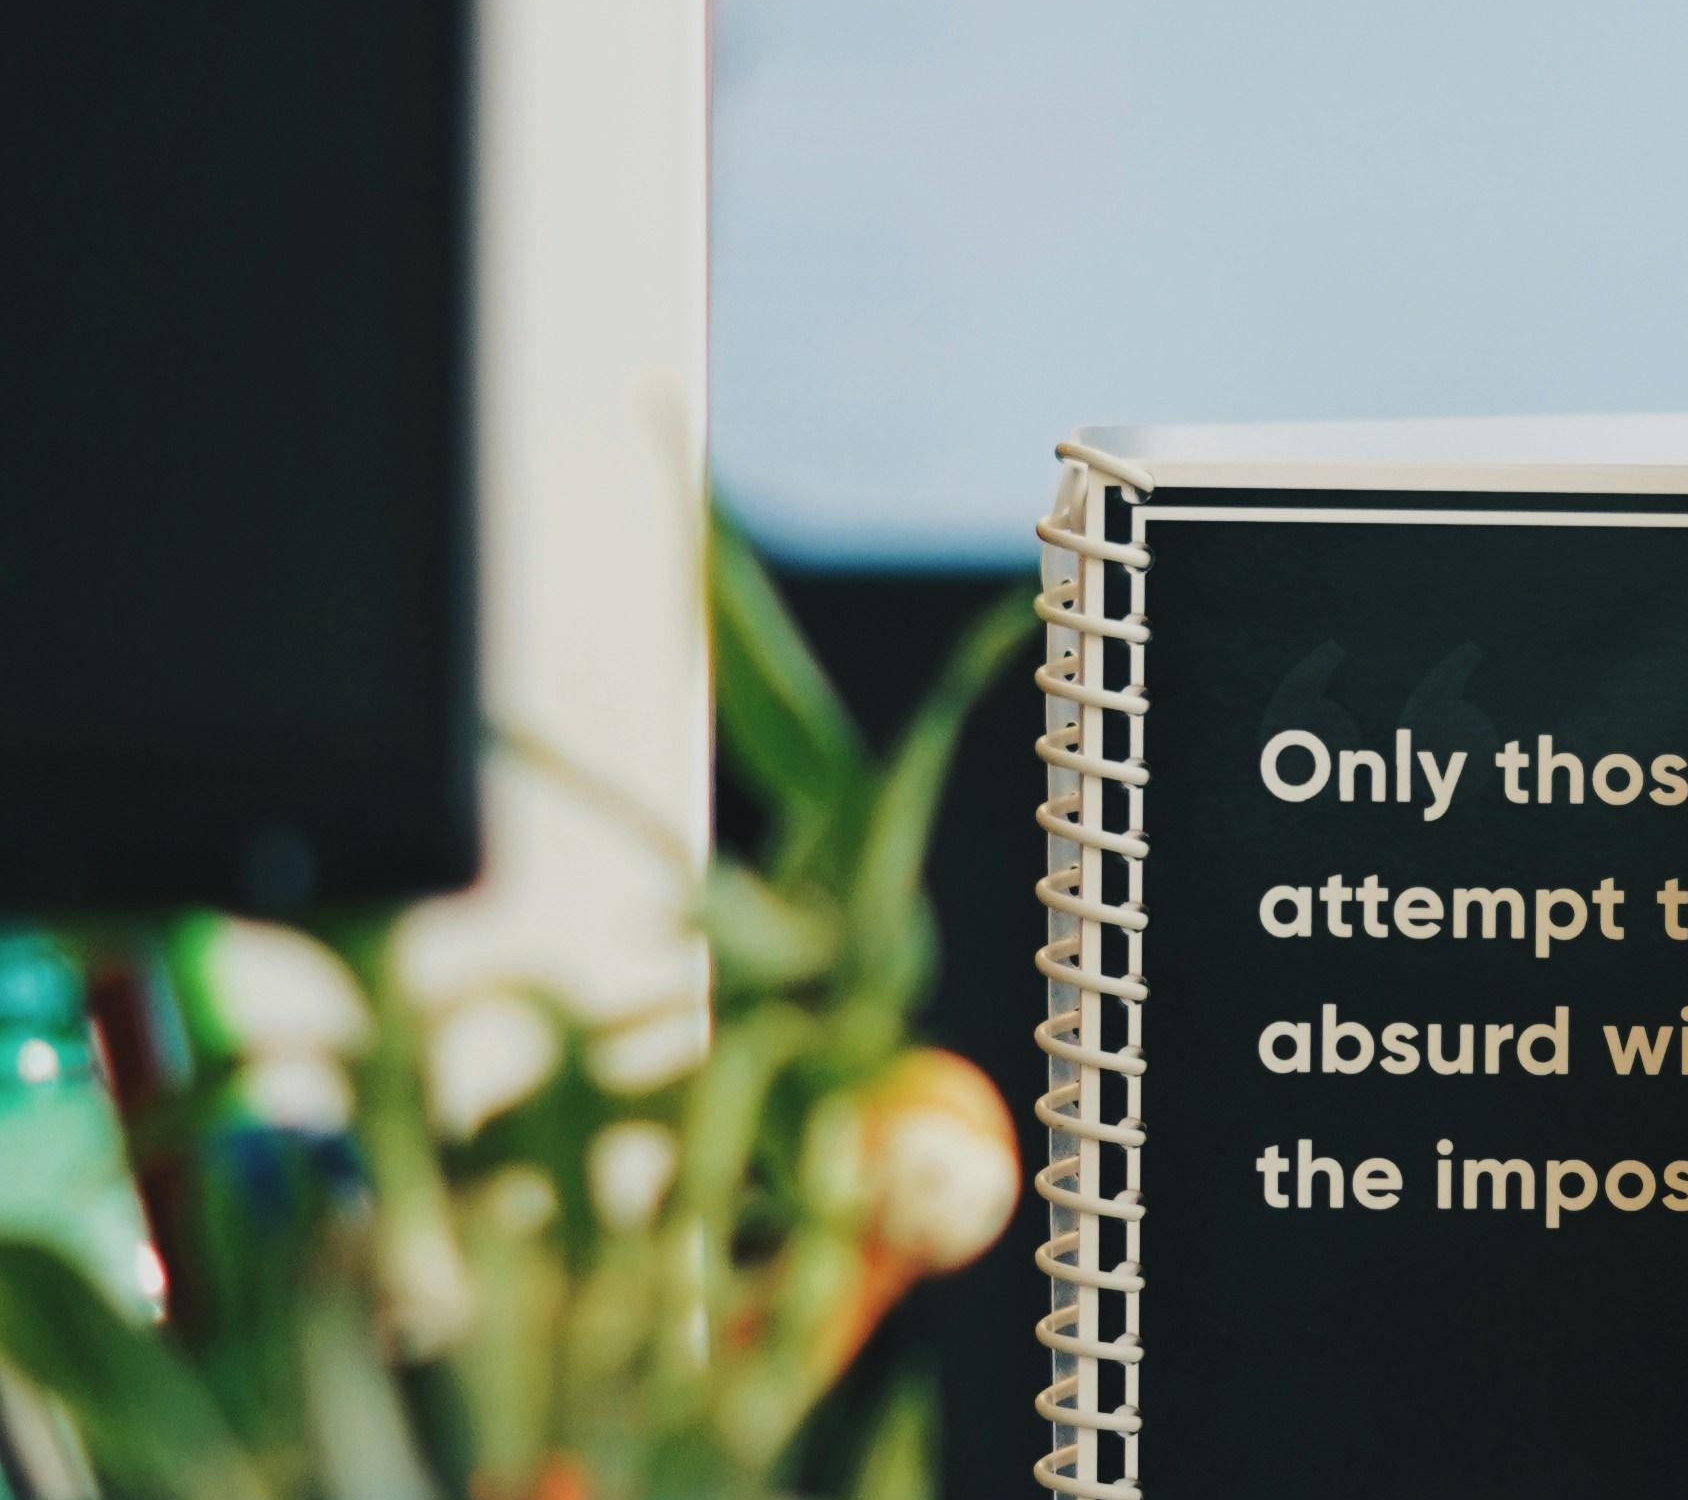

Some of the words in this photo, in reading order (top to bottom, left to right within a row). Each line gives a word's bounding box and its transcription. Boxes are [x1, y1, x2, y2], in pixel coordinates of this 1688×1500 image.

[1259, 728, 1468, 822] Only
[1258, 873, 1625, 959] attempt
[1258, 1003, 1570, 1076] absurd
[1255, 1138, 1404, 1211] the
